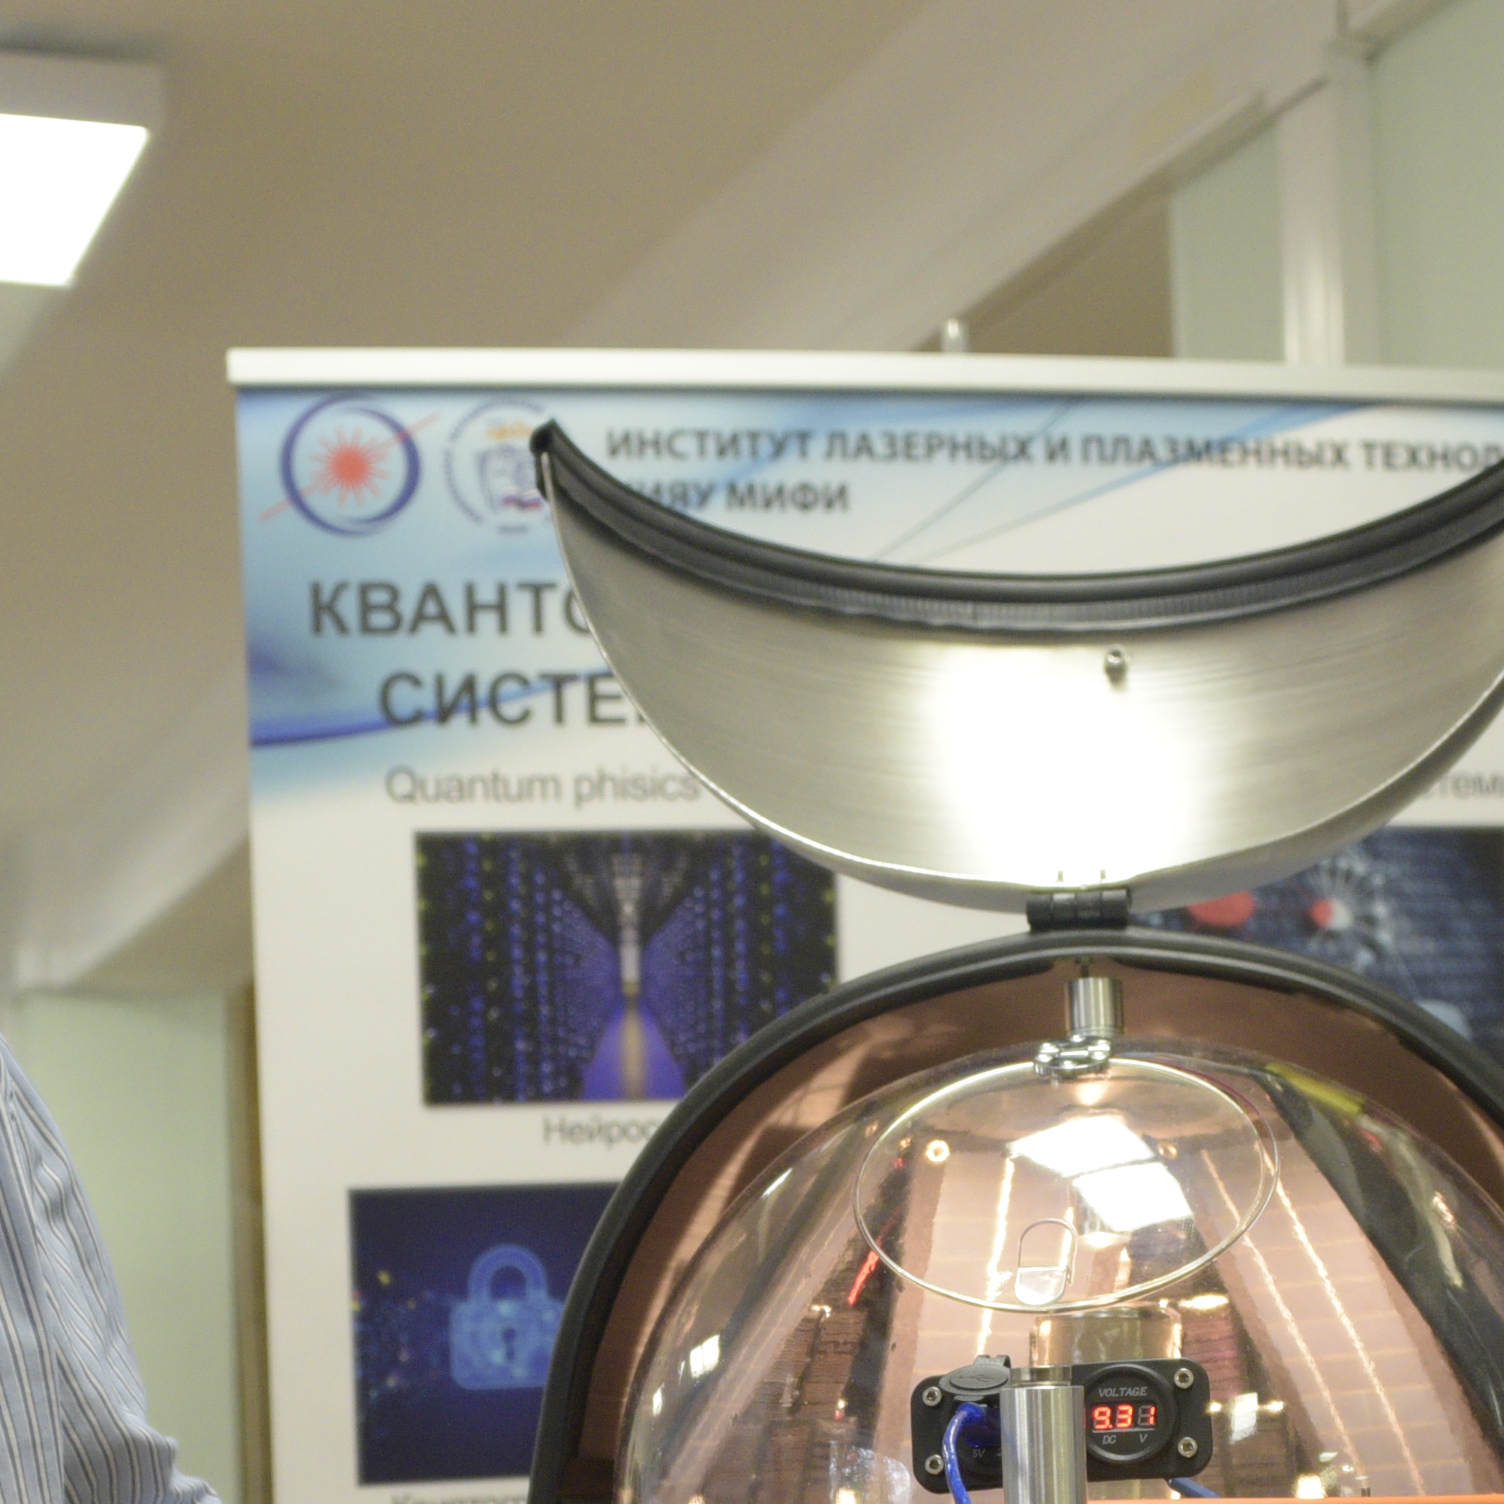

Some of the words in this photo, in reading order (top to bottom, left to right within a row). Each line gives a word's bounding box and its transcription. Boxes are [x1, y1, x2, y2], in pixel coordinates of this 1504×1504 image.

[606, 426, 811, 461] ИНСТИТУТ
[824, 429, 1033, 465] ЛАЗЕРНЫХ
[1047, 433, 1070, 465] И
[1081, 432, 1349, 470] ПЛАЗМЕННЫХ
[726, 481, 851, 514] МИФИ
[385, 765, 562, 804] Quantum
[573, 764, 702, 810] phisics
[1098, 1386, 1148, 1398] VOLTAGE
[1093, 1404, 1156, 1429] 9.31
[1102, 1434, 1117, 1445] DC
[1139, 1433, 1148, 1443] V
